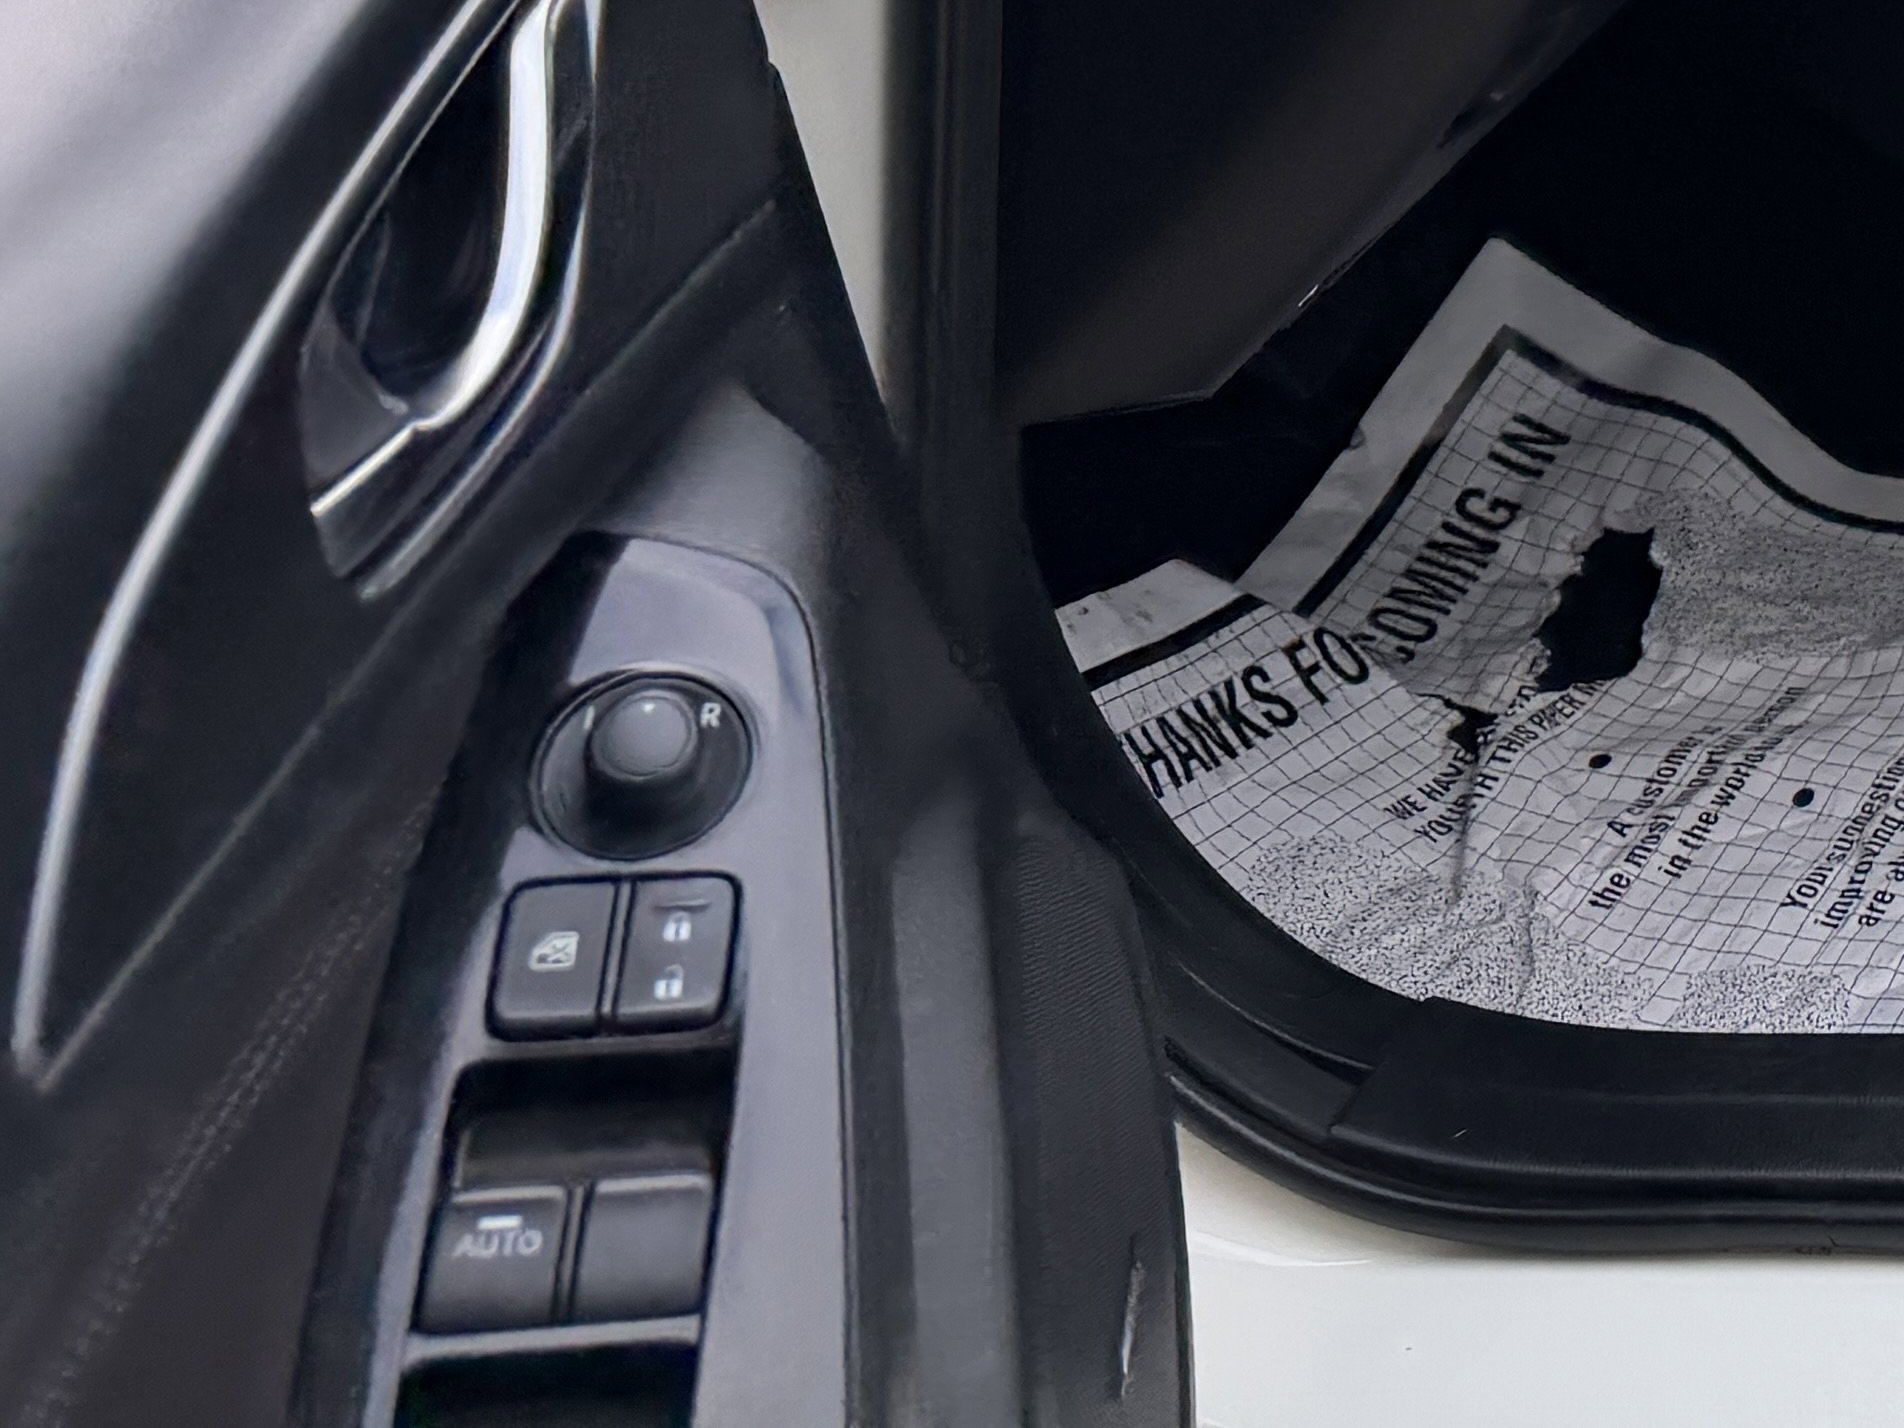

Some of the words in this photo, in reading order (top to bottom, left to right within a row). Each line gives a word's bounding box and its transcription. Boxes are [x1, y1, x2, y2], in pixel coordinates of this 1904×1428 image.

[1122, 665, 1298, 799] HANKS
[1282, 627, 1370, 706] FO
[1487, 414, 1570, 478] IN
[701, 702, 722, 728] R
[1486, 724, 1539, 766] THIS
[1384, 794, 1428, 821] WE
[1417, 748, 1476, 802] HAVE
[1608, 819, 1634, 838] A
[1658, 853, 1692, 879] in
[1679, 811, 1719, 850] the
[1588, 872, 1631, 910] the
[1624, 813, 1676, 869] most
[1780, 864, 1834, 909] Your
[1858, 889, 1896, 927] are
[452, 1229, 543, 1259] AUTO
